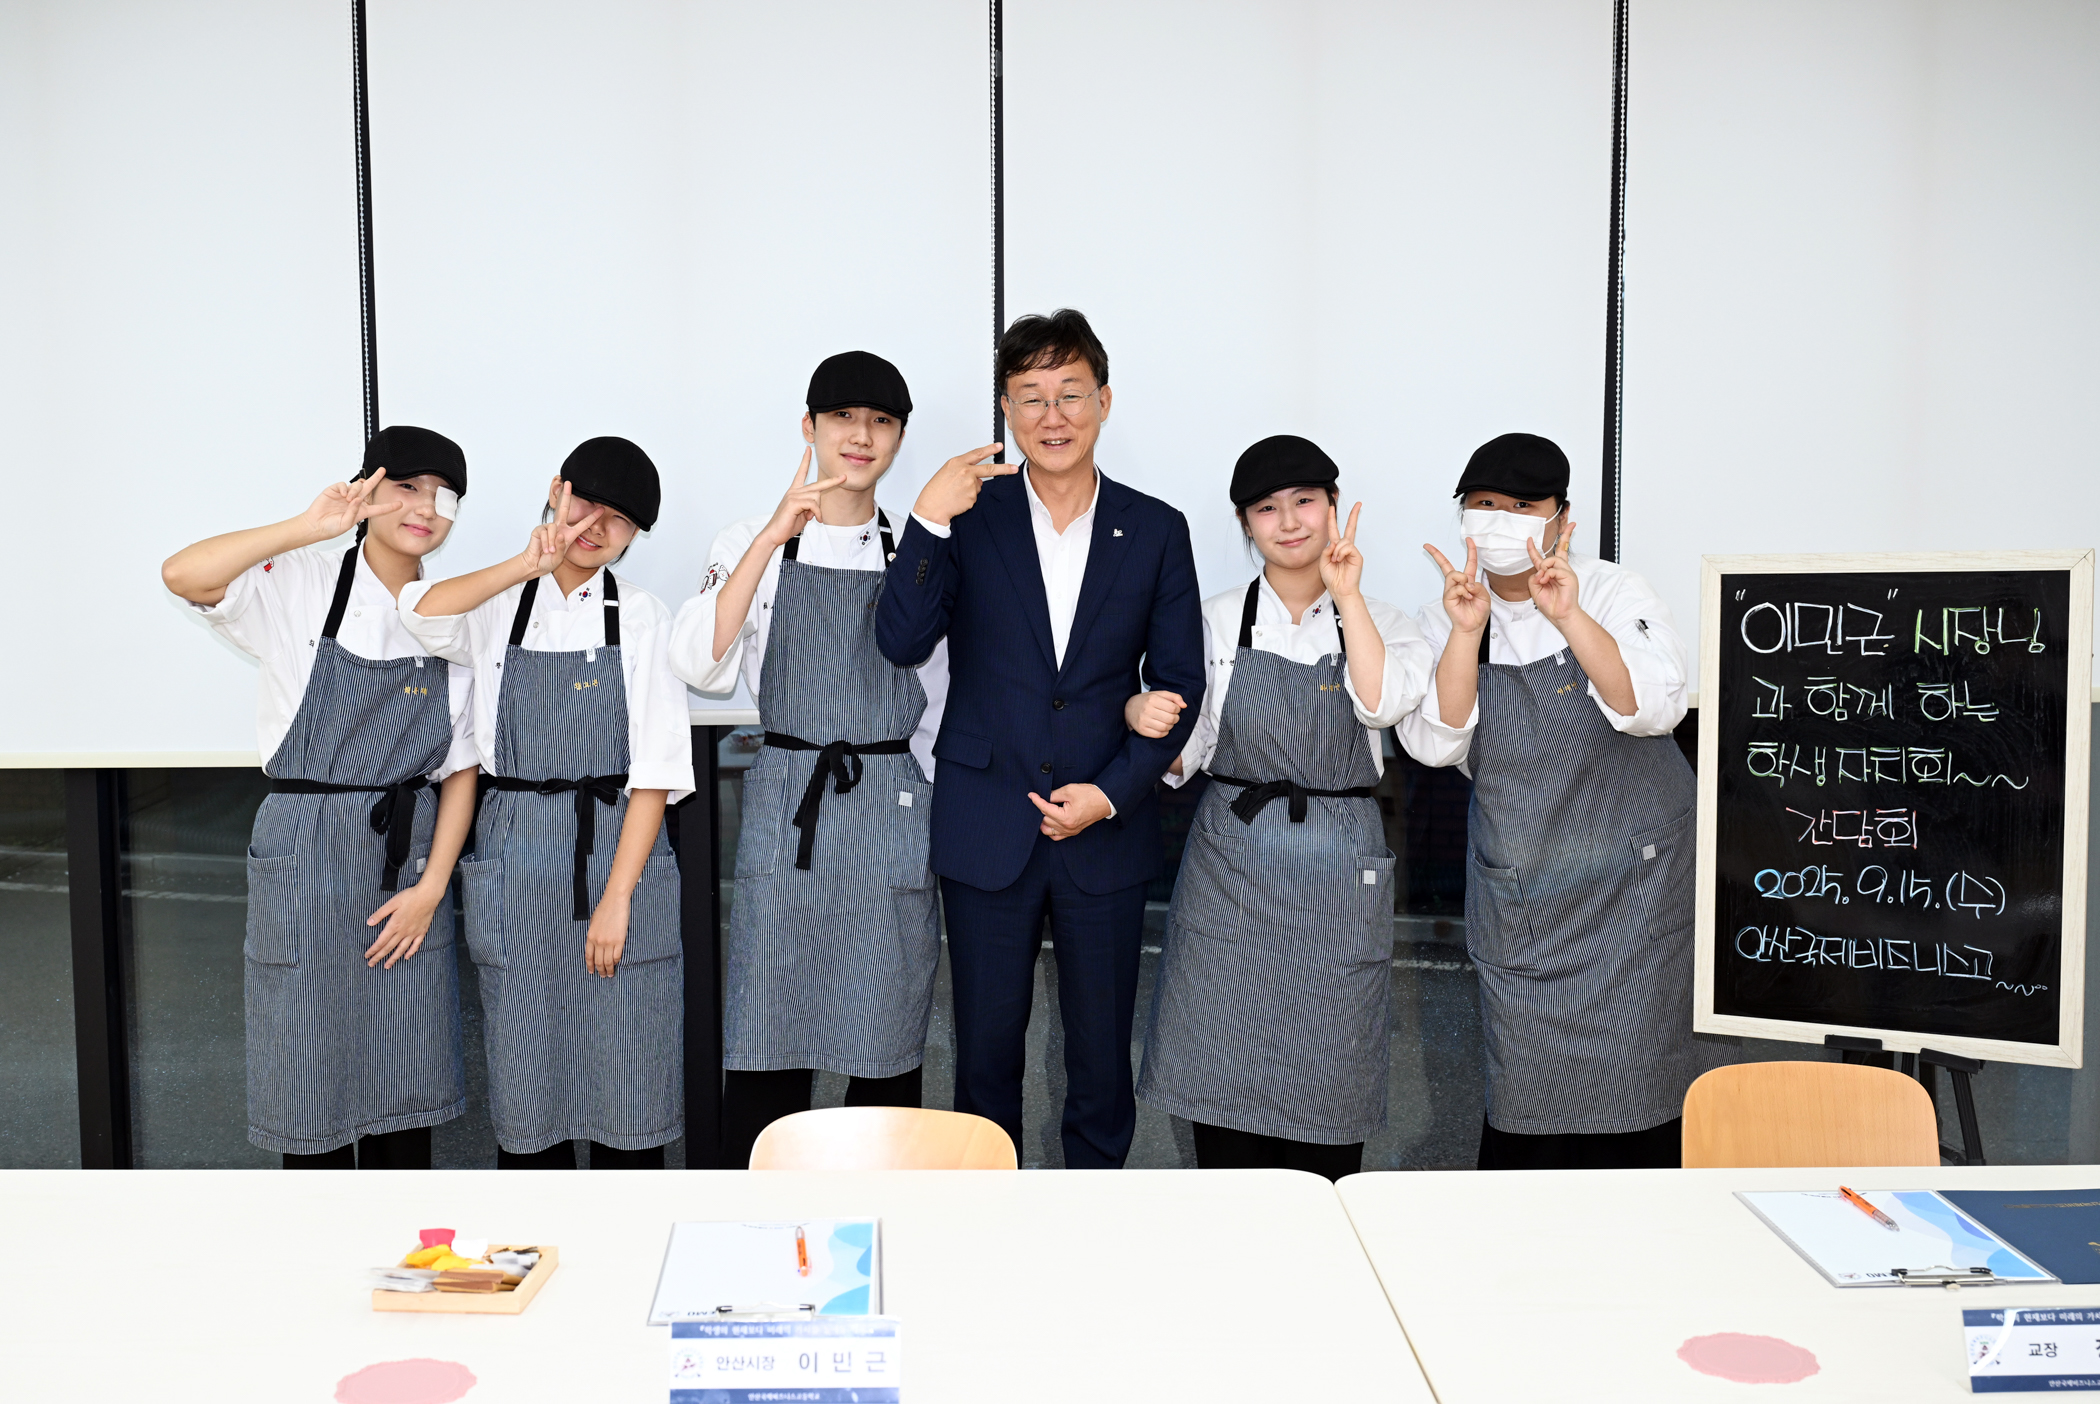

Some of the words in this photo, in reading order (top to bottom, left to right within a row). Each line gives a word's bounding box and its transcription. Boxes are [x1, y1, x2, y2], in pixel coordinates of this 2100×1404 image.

[1752, 676, 1792, 720] 과
[1804, 677, 1894, 721] 함께
[1917, 681, 1999, 721] 하는
[1786, 807, 1917, 849] 간담회
[716, 1356, 775, 1371] 안산시장
[2028, 1342, 2058, 1358] 교장
